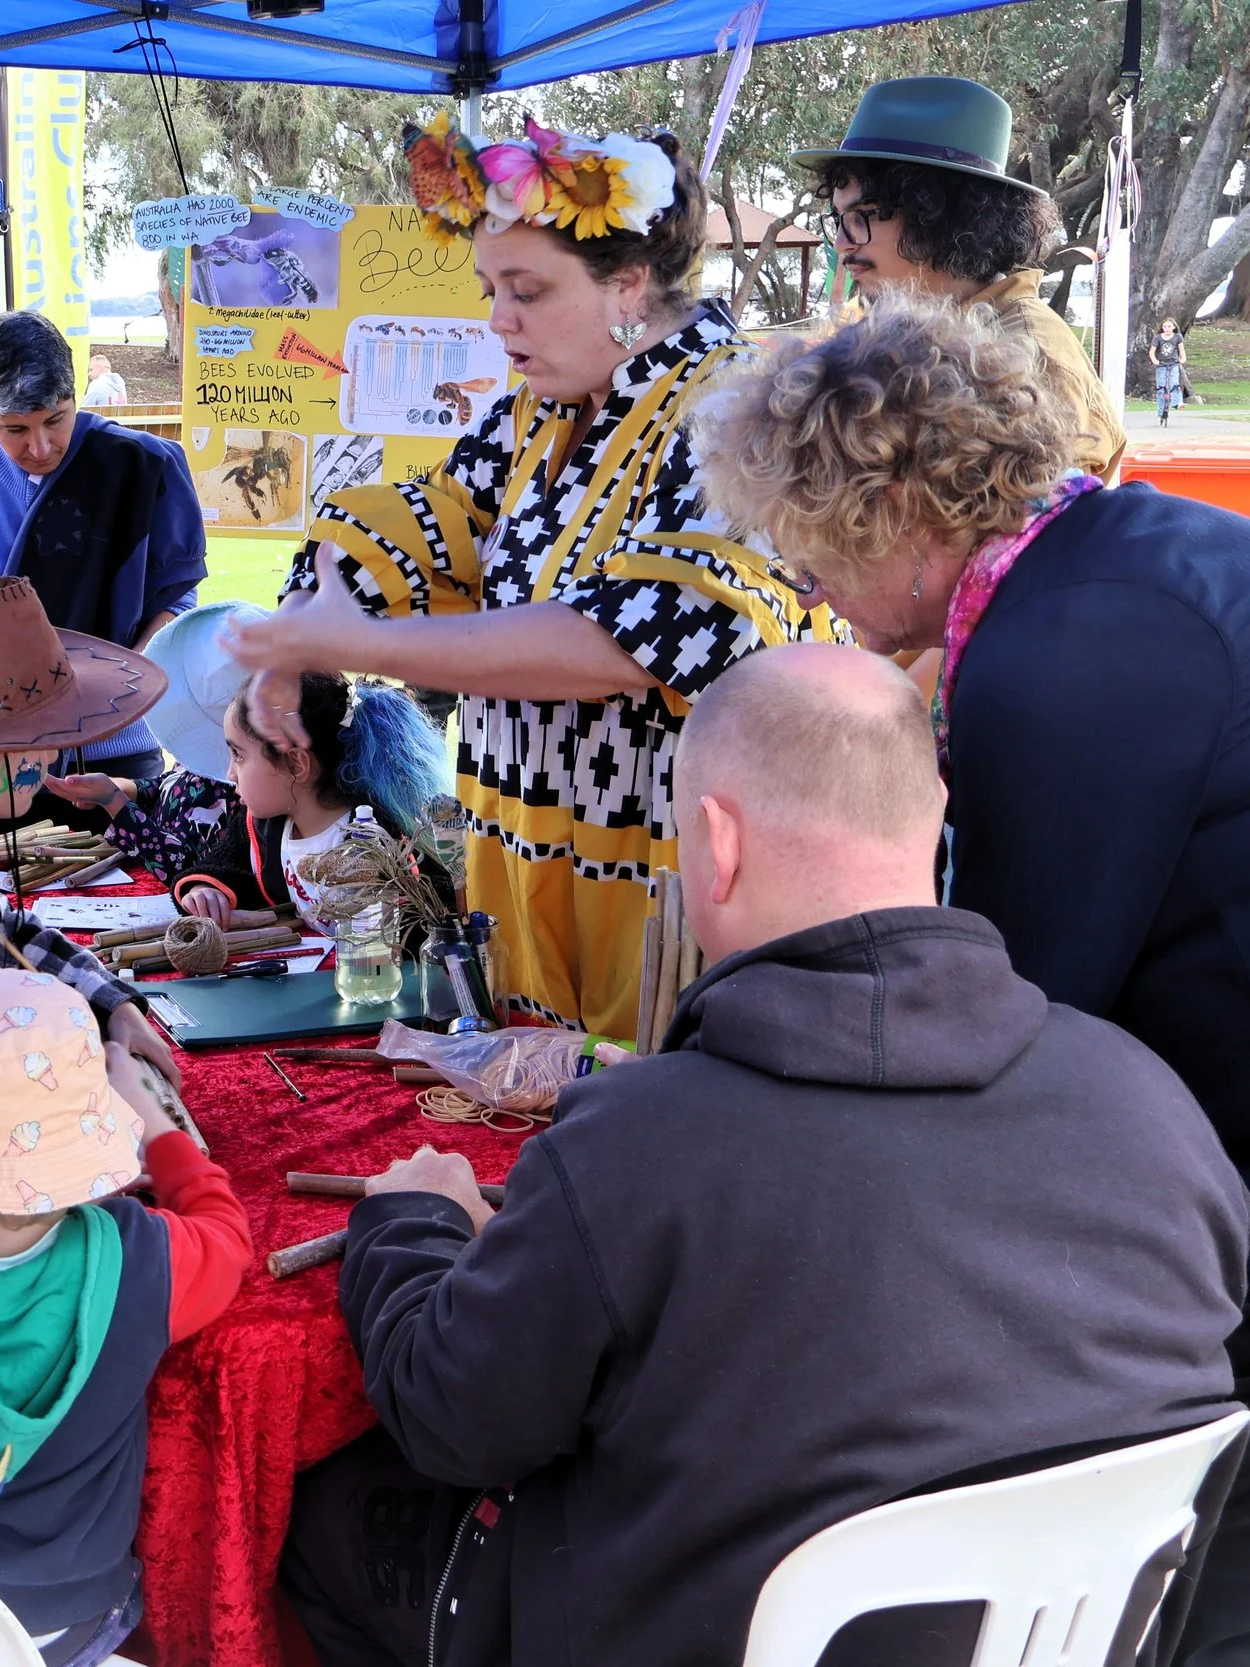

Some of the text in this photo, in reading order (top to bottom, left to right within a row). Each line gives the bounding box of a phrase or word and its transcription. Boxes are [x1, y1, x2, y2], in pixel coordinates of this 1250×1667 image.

[136, 199, 234, 219] AUSTRALIA HAS 2000
[257, 190, 337, 226] ARE ENDEMIC
[307, 194, 353, 218] PERCENT
[179, 218, 192, 226] OF
[195, 213, 229, 226] NATIVE
[388, 208, 421, 232] NA
[141, 234, 162, 247] 800
[181, 232, 199, 241] WA
[353, 229, 473, 293] Bee
[199, 361, 315, 380] BEES EVOLVED
[196, 383, 293, 405] 120 MILLION
[211, 405, 301, 425] YEARS AGO
